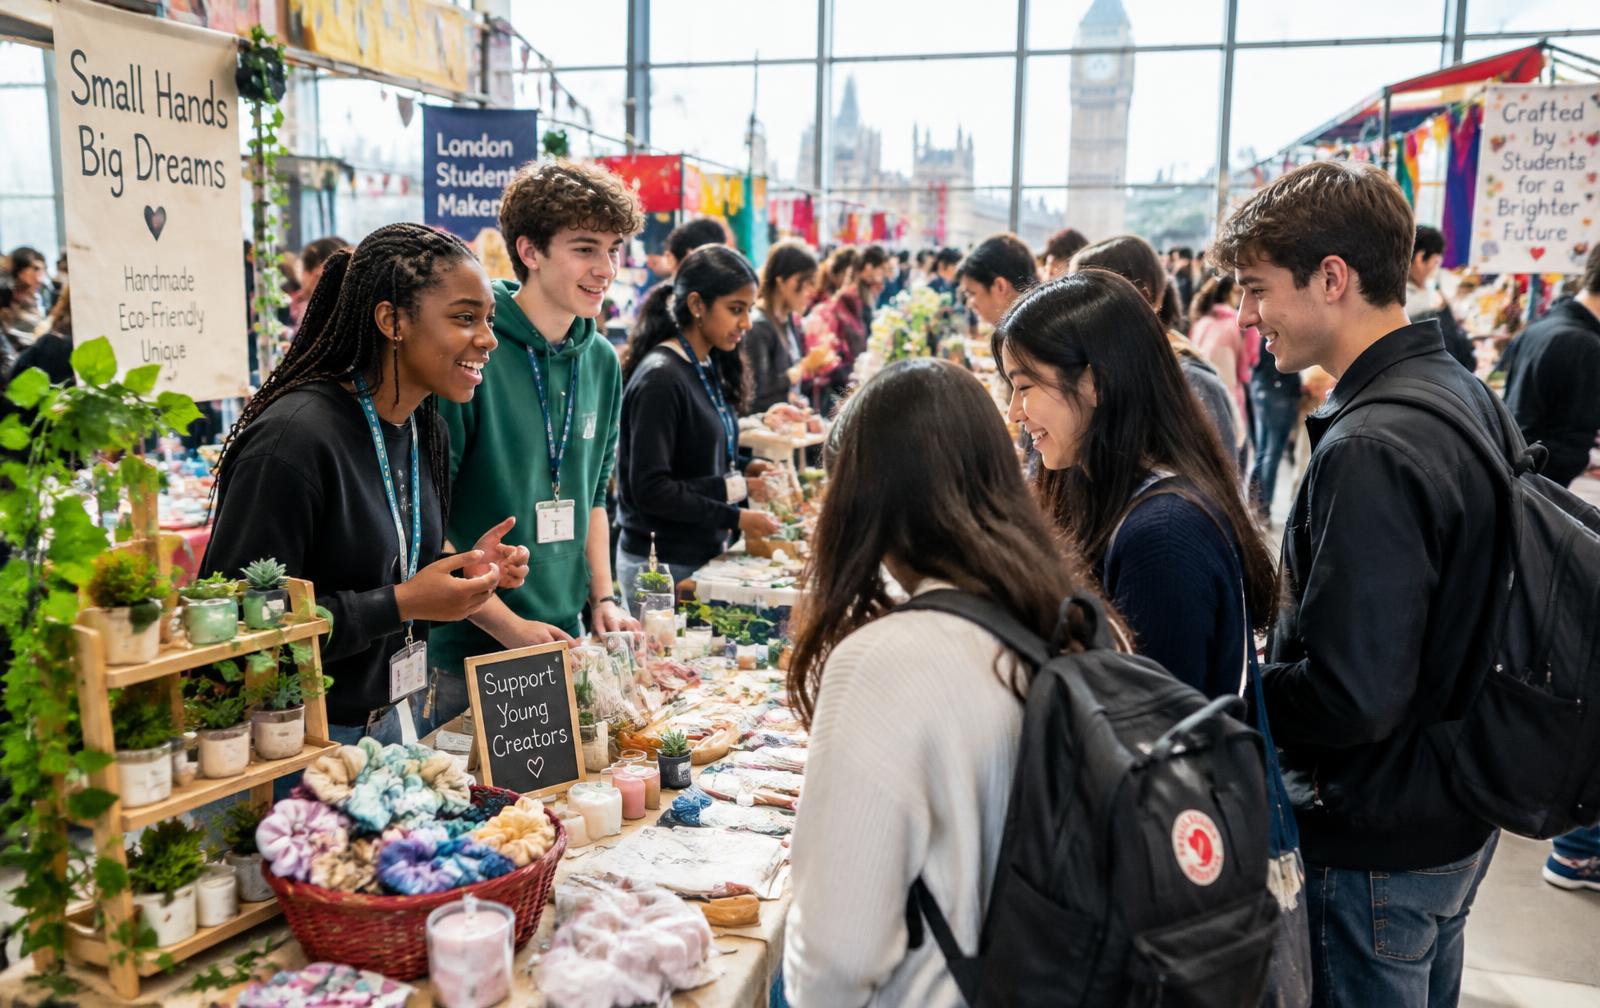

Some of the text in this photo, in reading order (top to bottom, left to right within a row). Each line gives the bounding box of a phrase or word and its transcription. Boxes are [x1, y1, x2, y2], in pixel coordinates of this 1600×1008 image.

[70, 49, 229, 129] Small Hands
[1502, 101, 1584, 123] Crafted
[436, 131, 514, 157] London
[1533, 127, 1556, 151] by
[78, 124, 226, 198] Big Dreams
[1502, 151, 1587, 171] Students
[1517, 175, 1564, 193] for a
[1497, 199, 1580, 223] Brighter
[1503, 222, 1568, 241] Future
[124, 264, 195, 293] Handmade
[118, 300, 205, 334] Eco-Friendly
[141, 339, 187, 382] Unique
[484, 665, 557, 699] Support
[496, 702, 549, 728] Young
[492, 728, 568, 757] Creators
